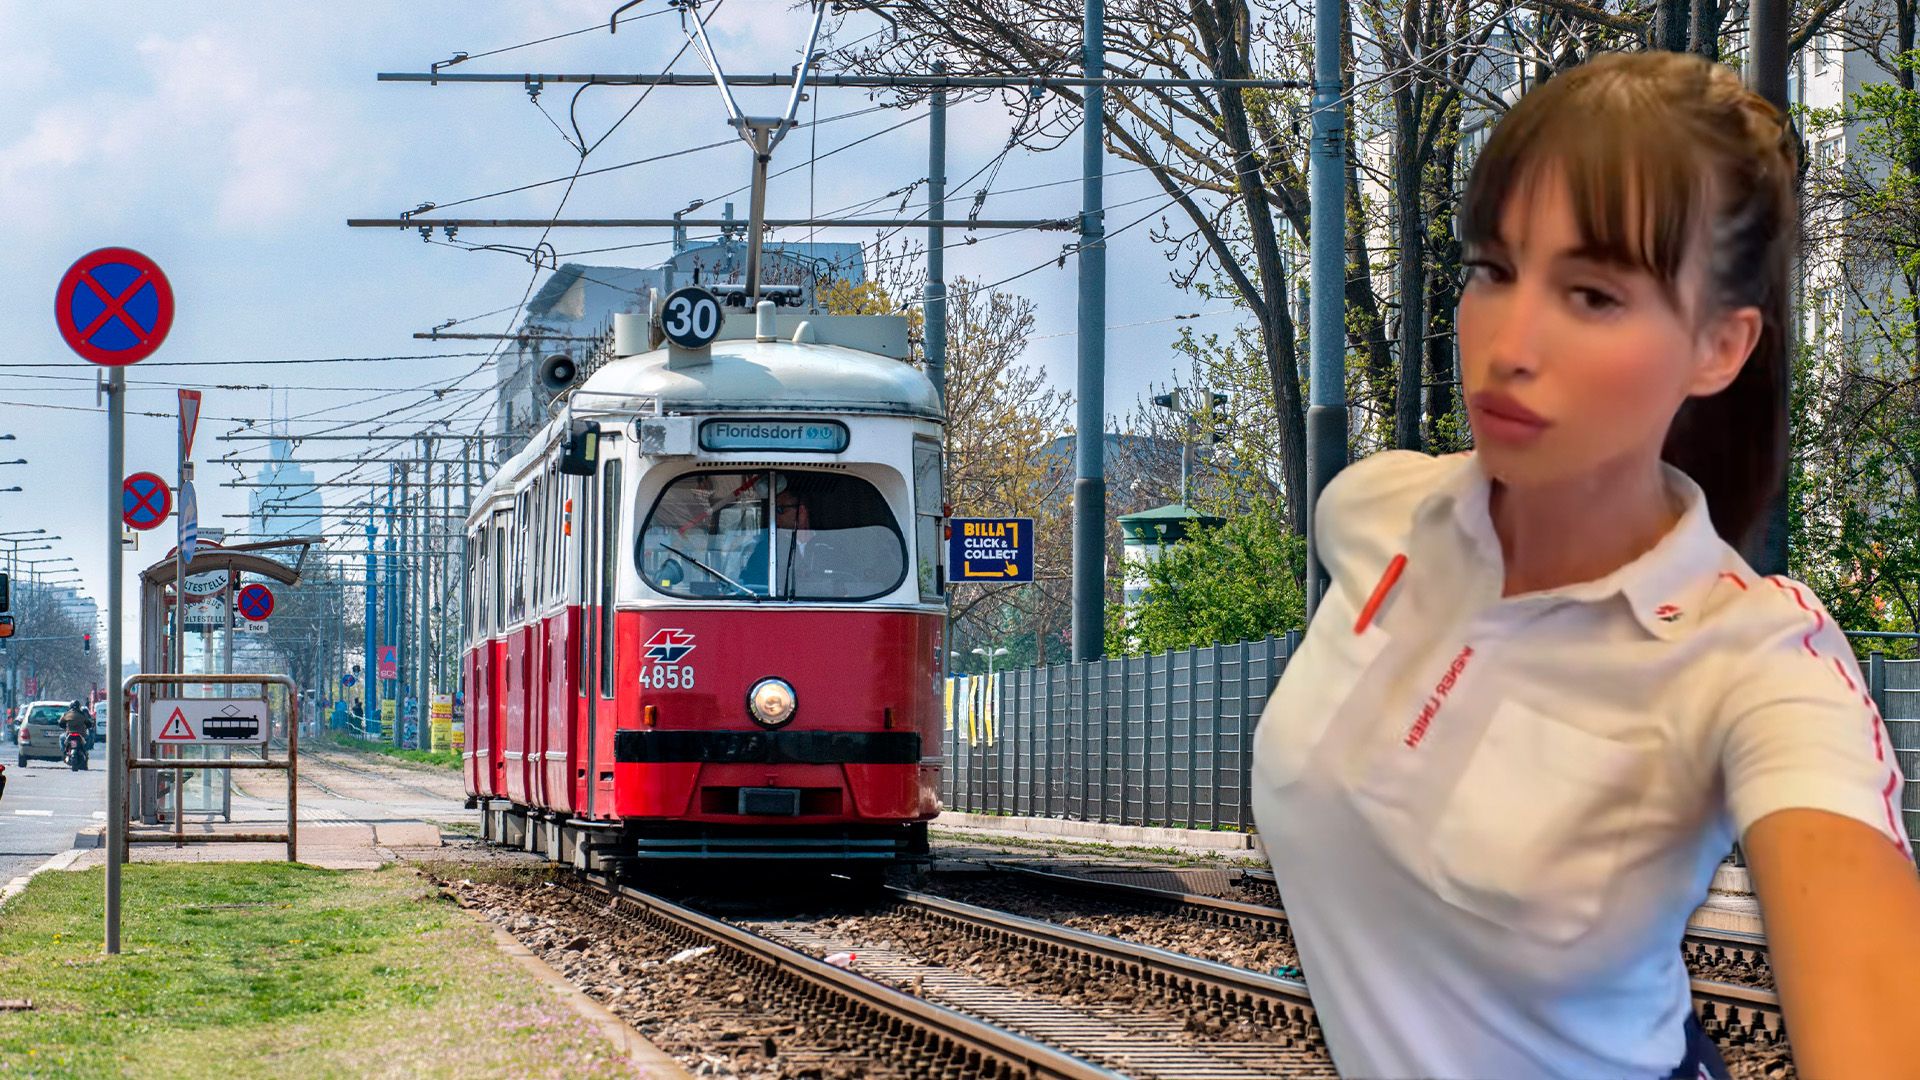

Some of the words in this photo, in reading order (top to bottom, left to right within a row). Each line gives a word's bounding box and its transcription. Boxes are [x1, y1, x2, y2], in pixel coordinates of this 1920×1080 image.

[666, 296, 717, 339] 30
[716, 424, 803, 439] Floridsdorf
[964, 522, 1005, 536] BILLA
[964, 538, 1000, 548] CLICK
[1001, 540, 1008, 548] &
[964, 550, 1018, 560] COLLECT
[184, 575, 227, 592] LTESTELLE
[249, 624, 264, 632] Ende
[639, 665, 695, 689] 4858
